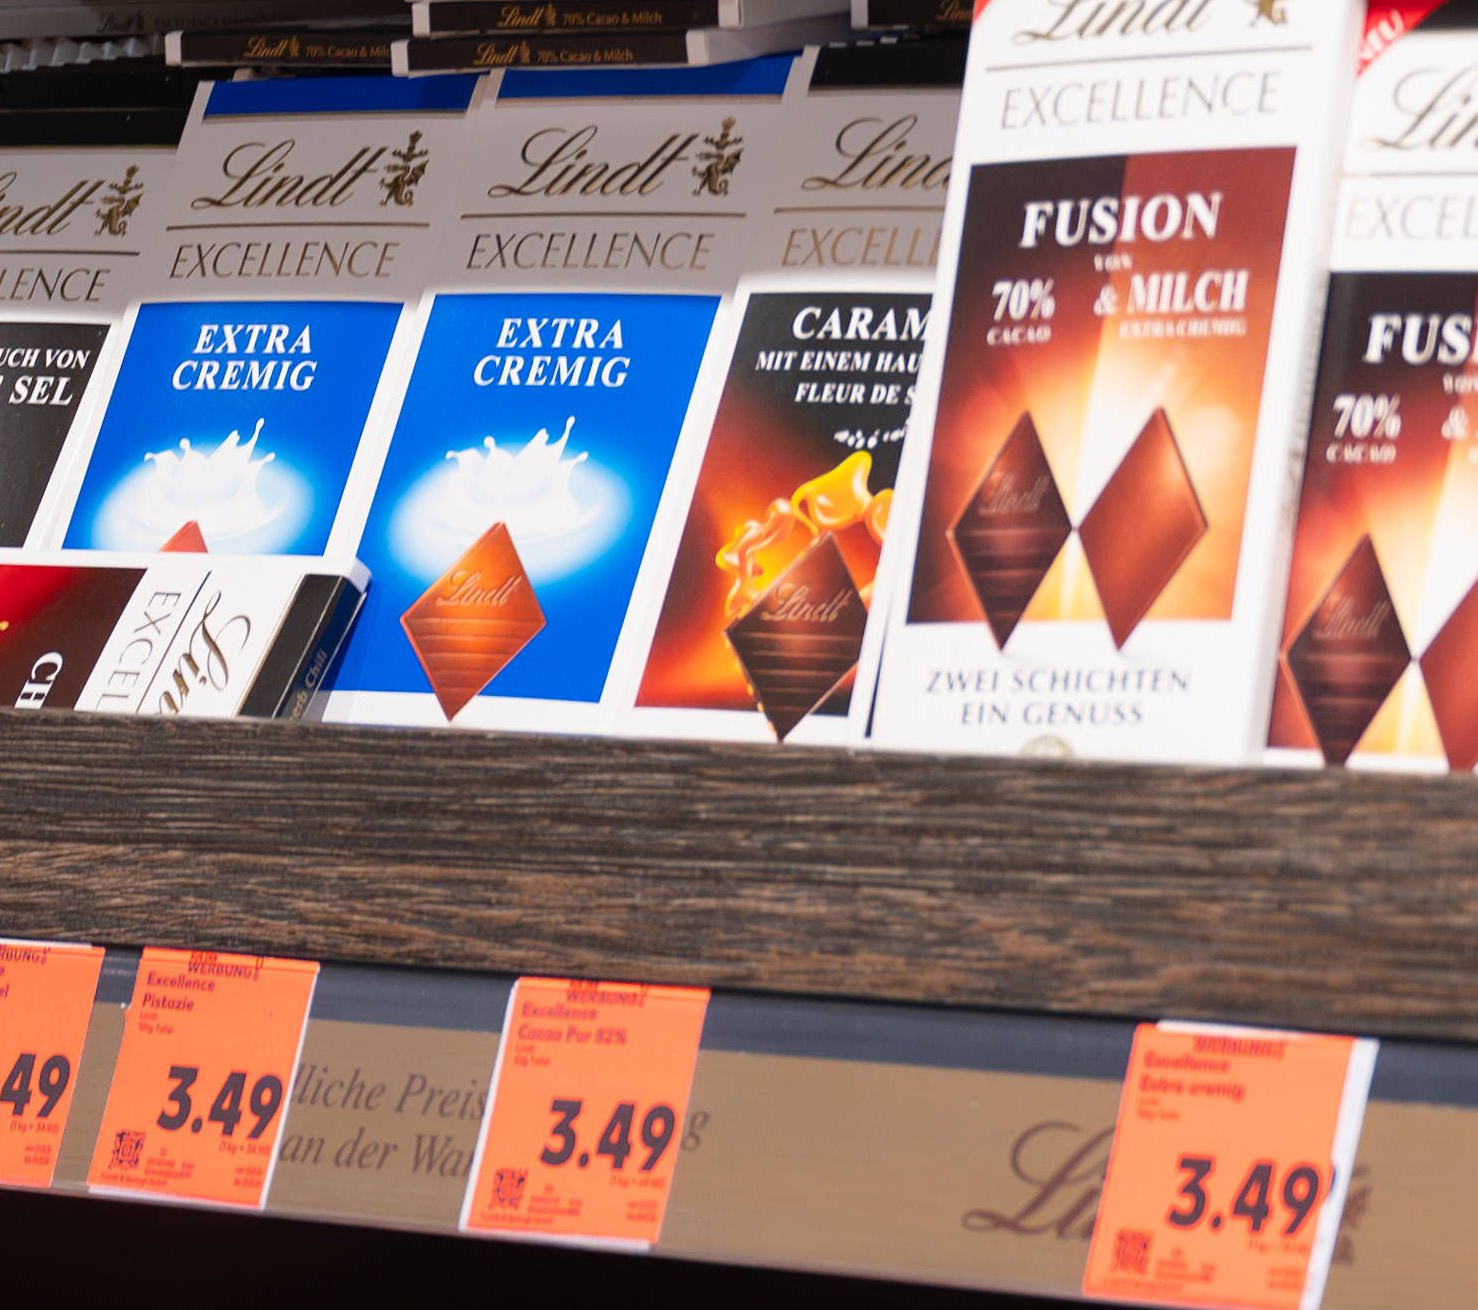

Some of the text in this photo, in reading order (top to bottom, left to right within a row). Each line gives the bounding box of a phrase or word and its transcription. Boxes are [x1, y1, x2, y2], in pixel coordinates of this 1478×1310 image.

[1000, 70, 1282, 131] EXCELLENCE
[192, 140, 378, 210] Lindt
[488, 123, 689, 199] Lindt
[1019, 192, 1225, 250] FUSION
[169, 241, 400, 280] EXCELLENCE
[465, 232, 716, 272] EXCELLENCE
[991, 270, 1251, 321] 70% & MILCH
[192, 323, 314, 355] EXTRA
[495, 315, 625, 349] EXTRA
[44, 348, 90, 370] VON
[170, 359, 319, 393] CREMIG
[472, 354, 631, 389] CREMIG
[755, 351, 870, 373] MIT EINEM
[8, 375, 75, 405] SEL
[1331, 395, 1402, 439] 70%
[925, 667, 1191, 695] ZWEI SCHICHTEN
[960, 698, 1146, 727] EIN GENUSS
[146, 971, 216, 992] Excellence
[142, 993, 195, 1013] Pistazie
[156, 1063, 283, 1140] 3.49
[540, 1099, 676, 1172] 3.49
